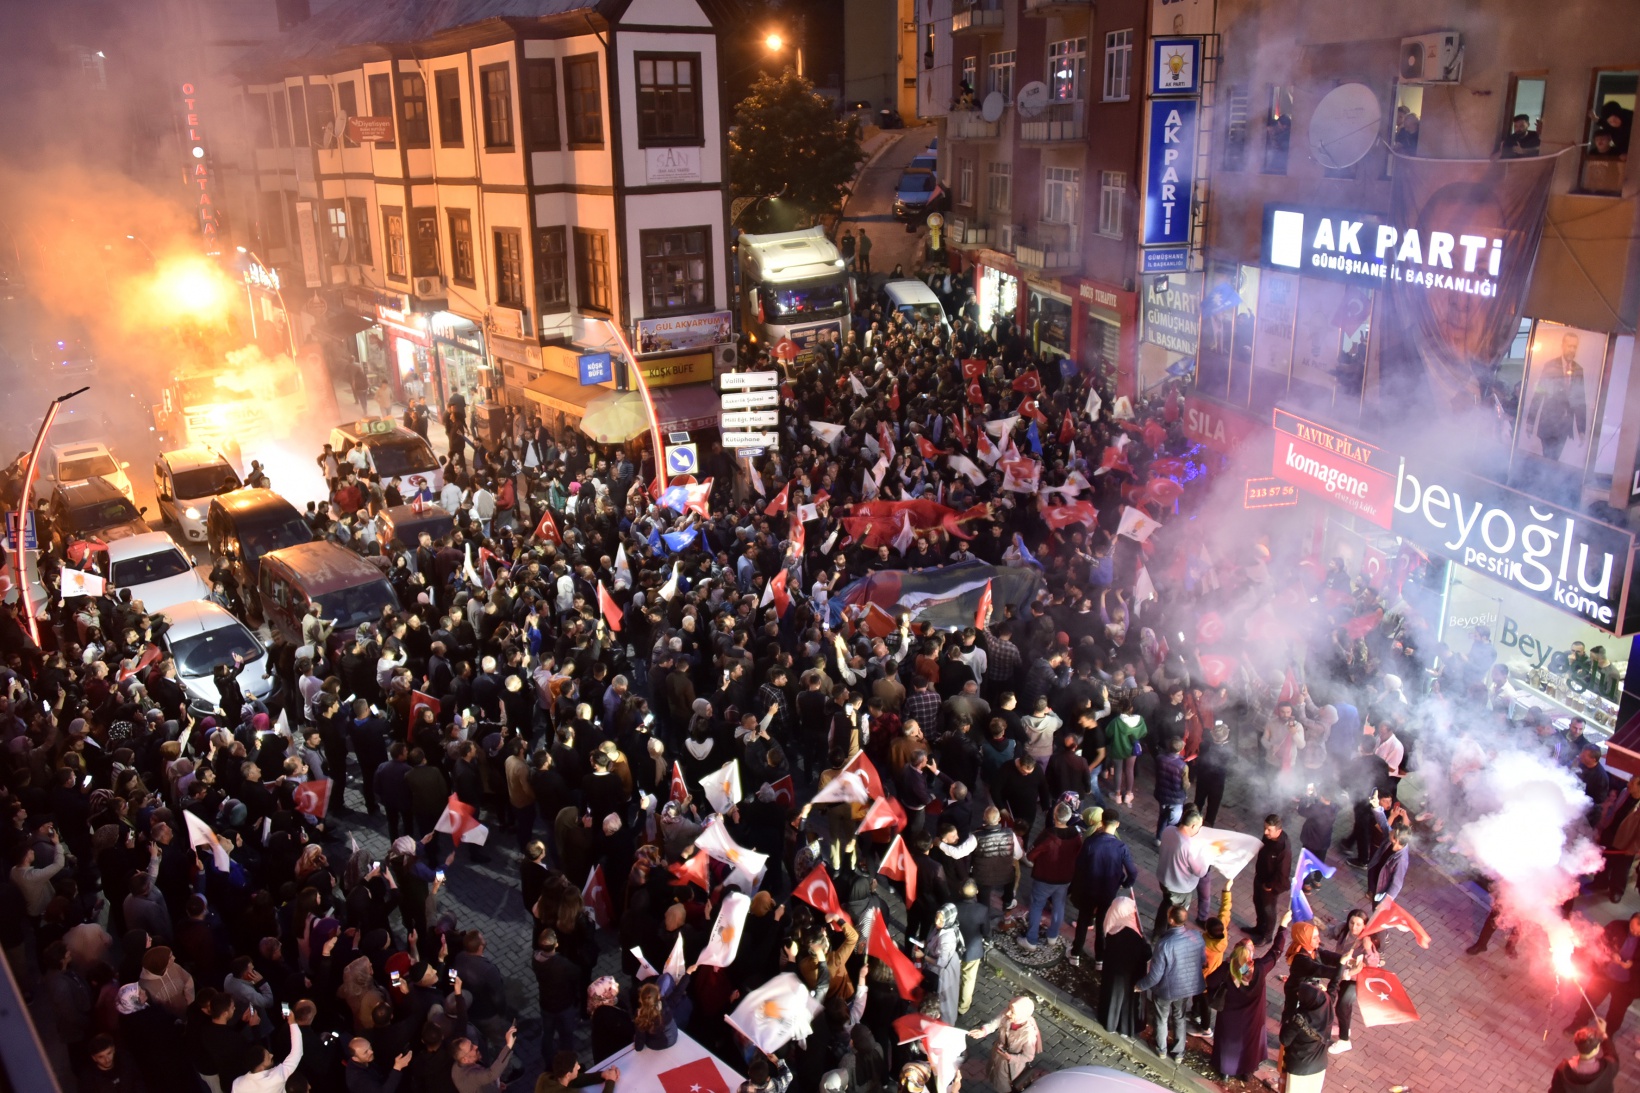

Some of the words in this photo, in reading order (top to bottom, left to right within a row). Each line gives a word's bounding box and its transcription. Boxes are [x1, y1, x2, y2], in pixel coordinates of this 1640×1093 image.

[1164, 109, 1182, 143] AK
[182, 83, 201, 141] OTEL
[195, 164, 217, 249] ATALAY
[1312, 218, 1364, 255] AK
[1147, 253, 1184, 261] GÜMÜŞHANE
[1153, 260, 1184, 268] BAŞKANLIĞI
[1311, 253, 1387, 278] GÜMÜŞHANE
[1390, 265, 1402, 281] İL
[1405, 269, 1497, 297] BAŞKANLIĞI
[1148, 284, 1164, 307] AK
[655, 321, 673, 331] GÜL
[675, 317, 721, 329] AKVARYUM
[1147, 308, 1200, 335] GÜMÜŞHAN
[1148, 327, 1155, 343] İL
[587, 362, 603, 371] KÖŞK
[588, 369, 604, 378] BÜFE
[649, 365, 672, 378] KÖŞK
[672, 363, 694, 375] BÜFE
[1188, 408, 1226, 444] SILA
[1297, 422, 1335, 450] TAVUK
[1336, 437, 1372, 464] PİLAV
[1285, 442, 1369, 499] komagene
[1249, 488, 1267, 498] 213
[1269, 487, 1281, 496] 57
[1282, 486, 1294, 495] 56
[1394, 456, 1614, 600] beyoğlu
[1464, 546, 1515, 581] pestil
[1553, 581, 1613, 624] köme
[1449, 612, 1497, 629] Beyoğlu
[1500, 615, 1620, 702] Beyoğlu
